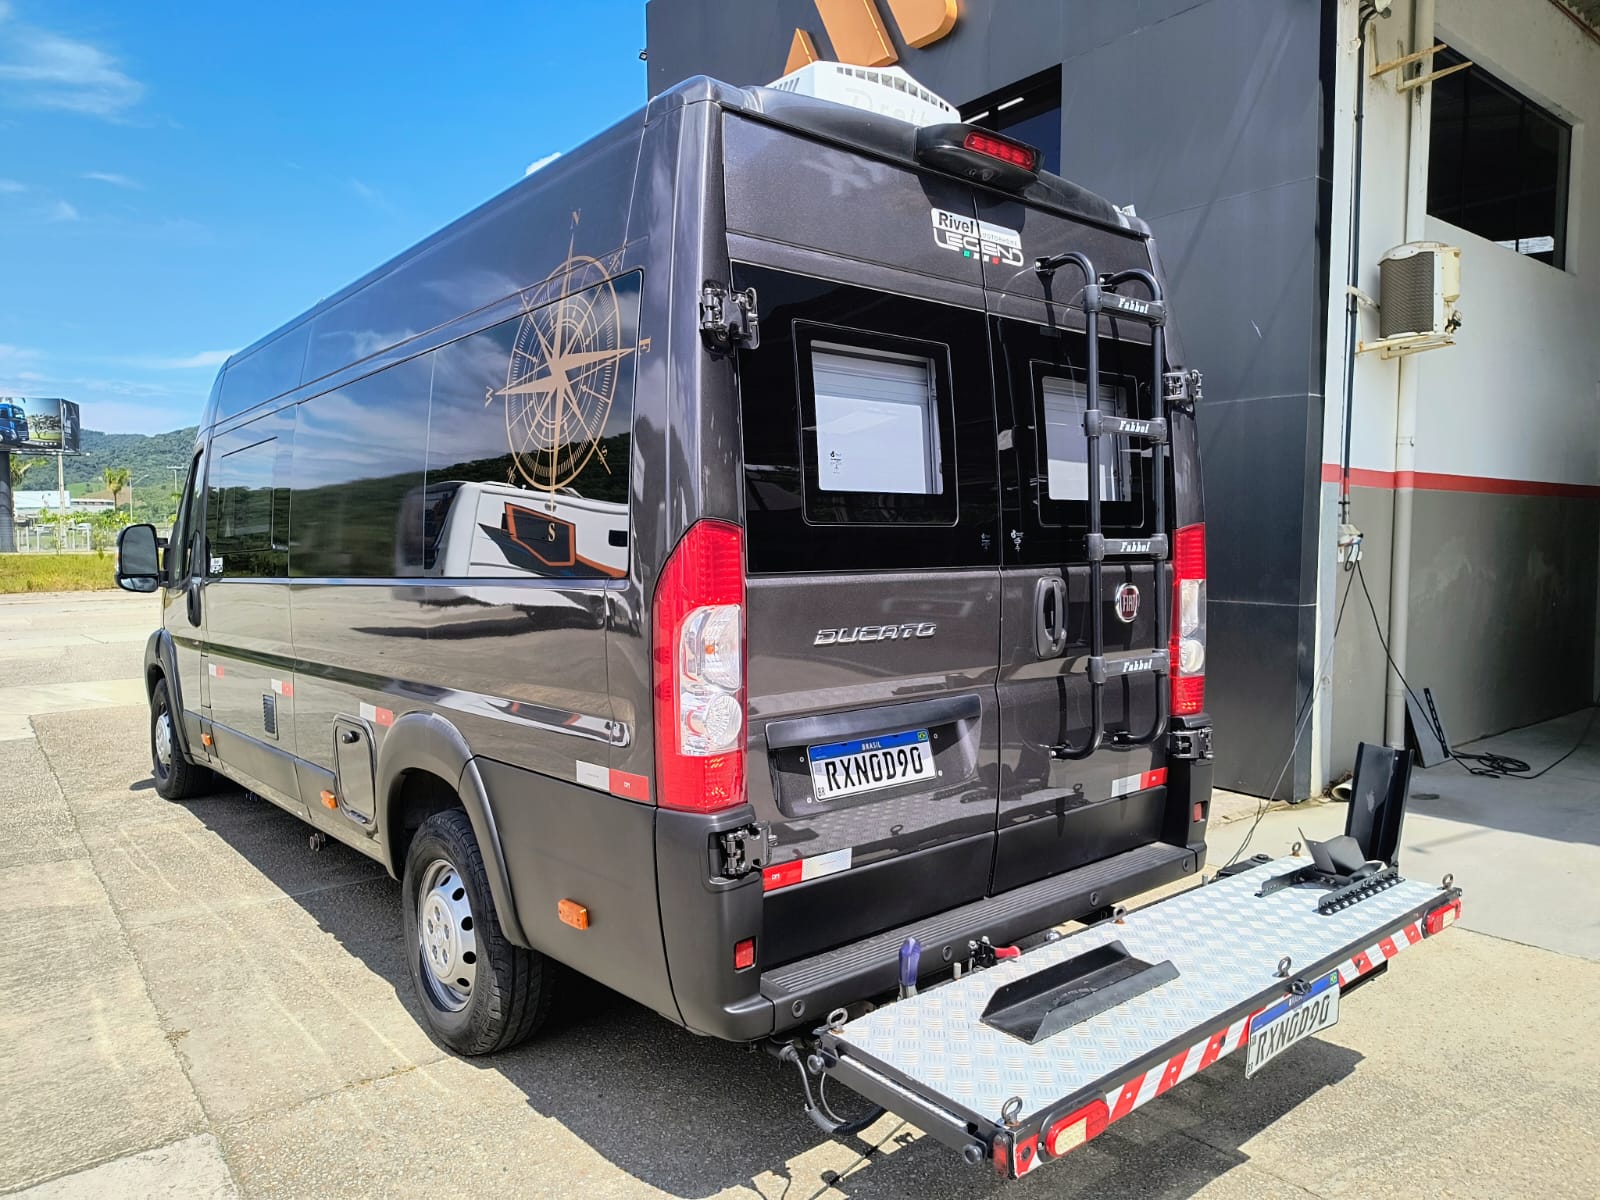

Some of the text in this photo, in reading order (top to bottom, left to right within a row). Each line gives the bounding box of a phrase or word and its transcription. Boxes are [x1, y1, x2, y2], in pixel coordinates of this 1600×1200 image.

[570, 208, 581, 230] N
[938, 211, 974, 234] Rivel
[933, 227, 1024, 267] LEGEND
[547, 522, 556, 542] S
[1122, 594, 1136, 612] FIAT
[813, 622, 937, 645] DUCATO
[861, 740, 882, 750] BRASIL
